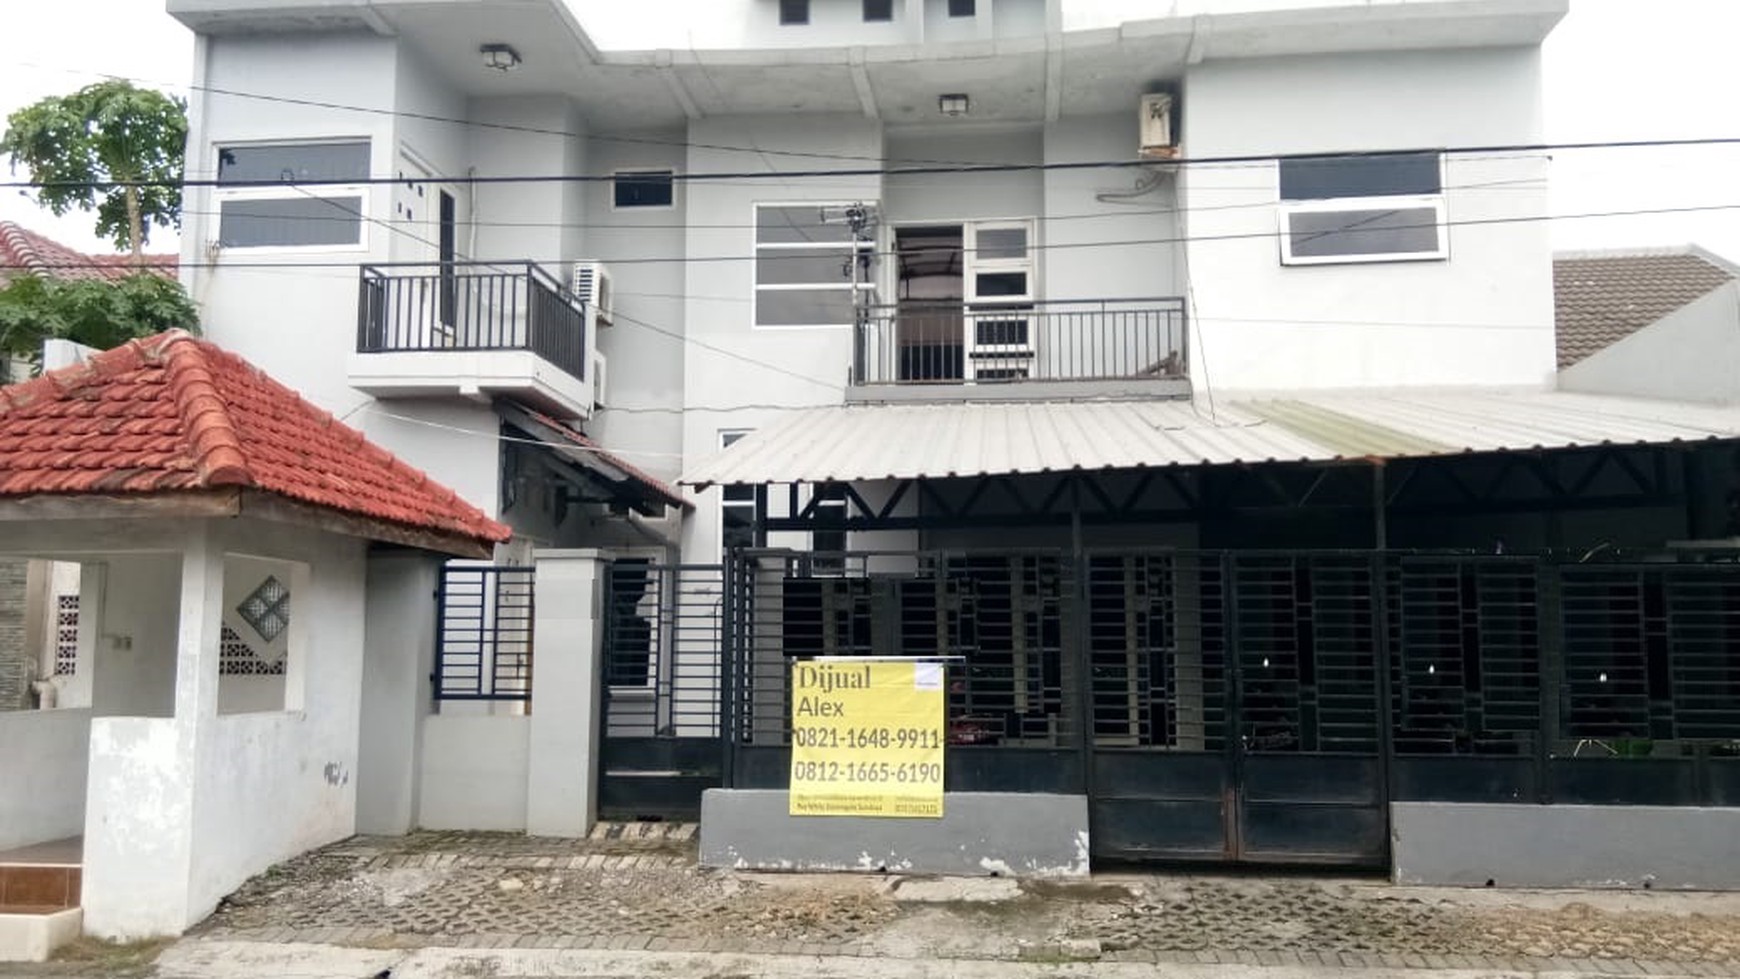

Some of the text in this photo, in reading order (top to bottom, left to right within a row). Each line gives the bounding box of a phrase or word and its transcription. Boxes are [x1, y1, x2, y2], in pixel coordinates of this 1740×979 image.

[798, 665, 870, 693] Dijual
[796, 696, 844, 717] Alex
[797, 727, 940, 749] 0821-1648-9911
[795, 761, 941, 783] 0812-1665-6190
